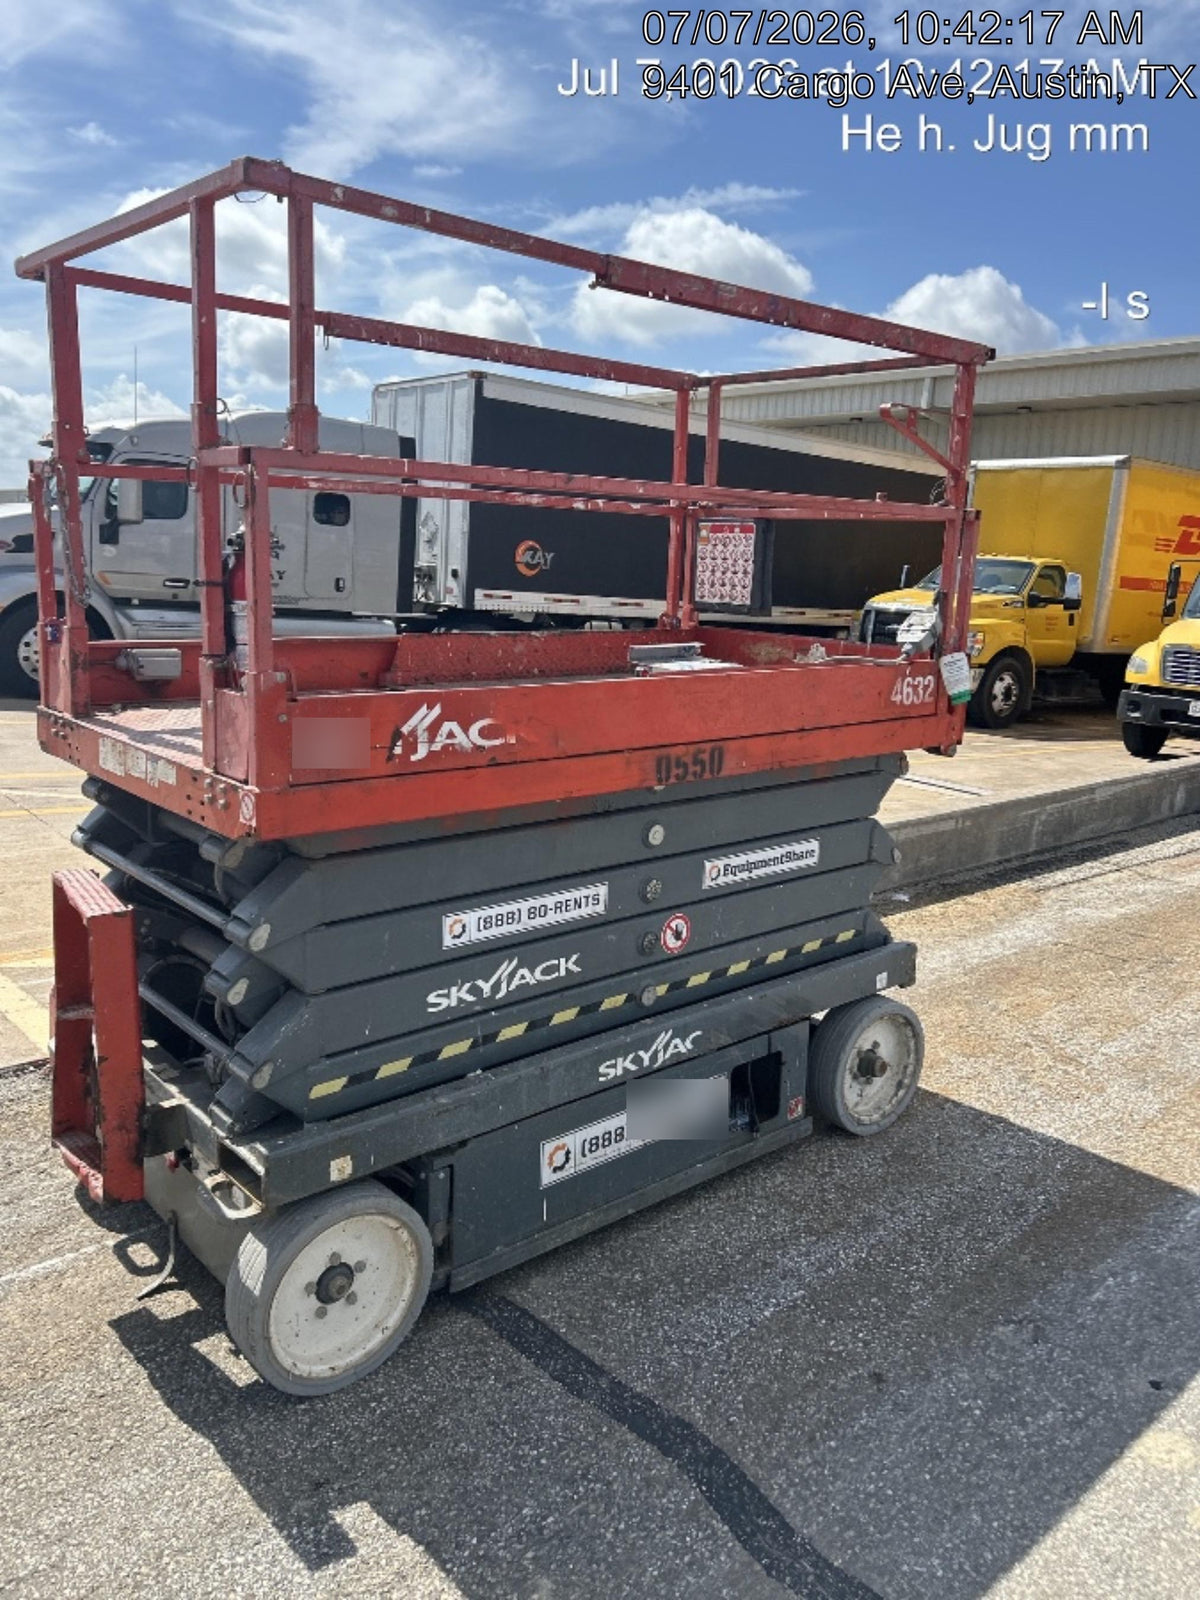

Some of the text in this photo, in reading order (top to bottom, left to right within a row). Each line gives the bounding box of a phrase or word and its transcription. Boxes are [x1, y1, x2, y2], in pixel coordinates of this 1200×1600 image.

[890, 674, 935, 706] 4632
[722, 849, 816, 877] EquipmentShare
[477, 908, 522, 932] (888)
[426, 952, 582, 1013] SKYJACK
